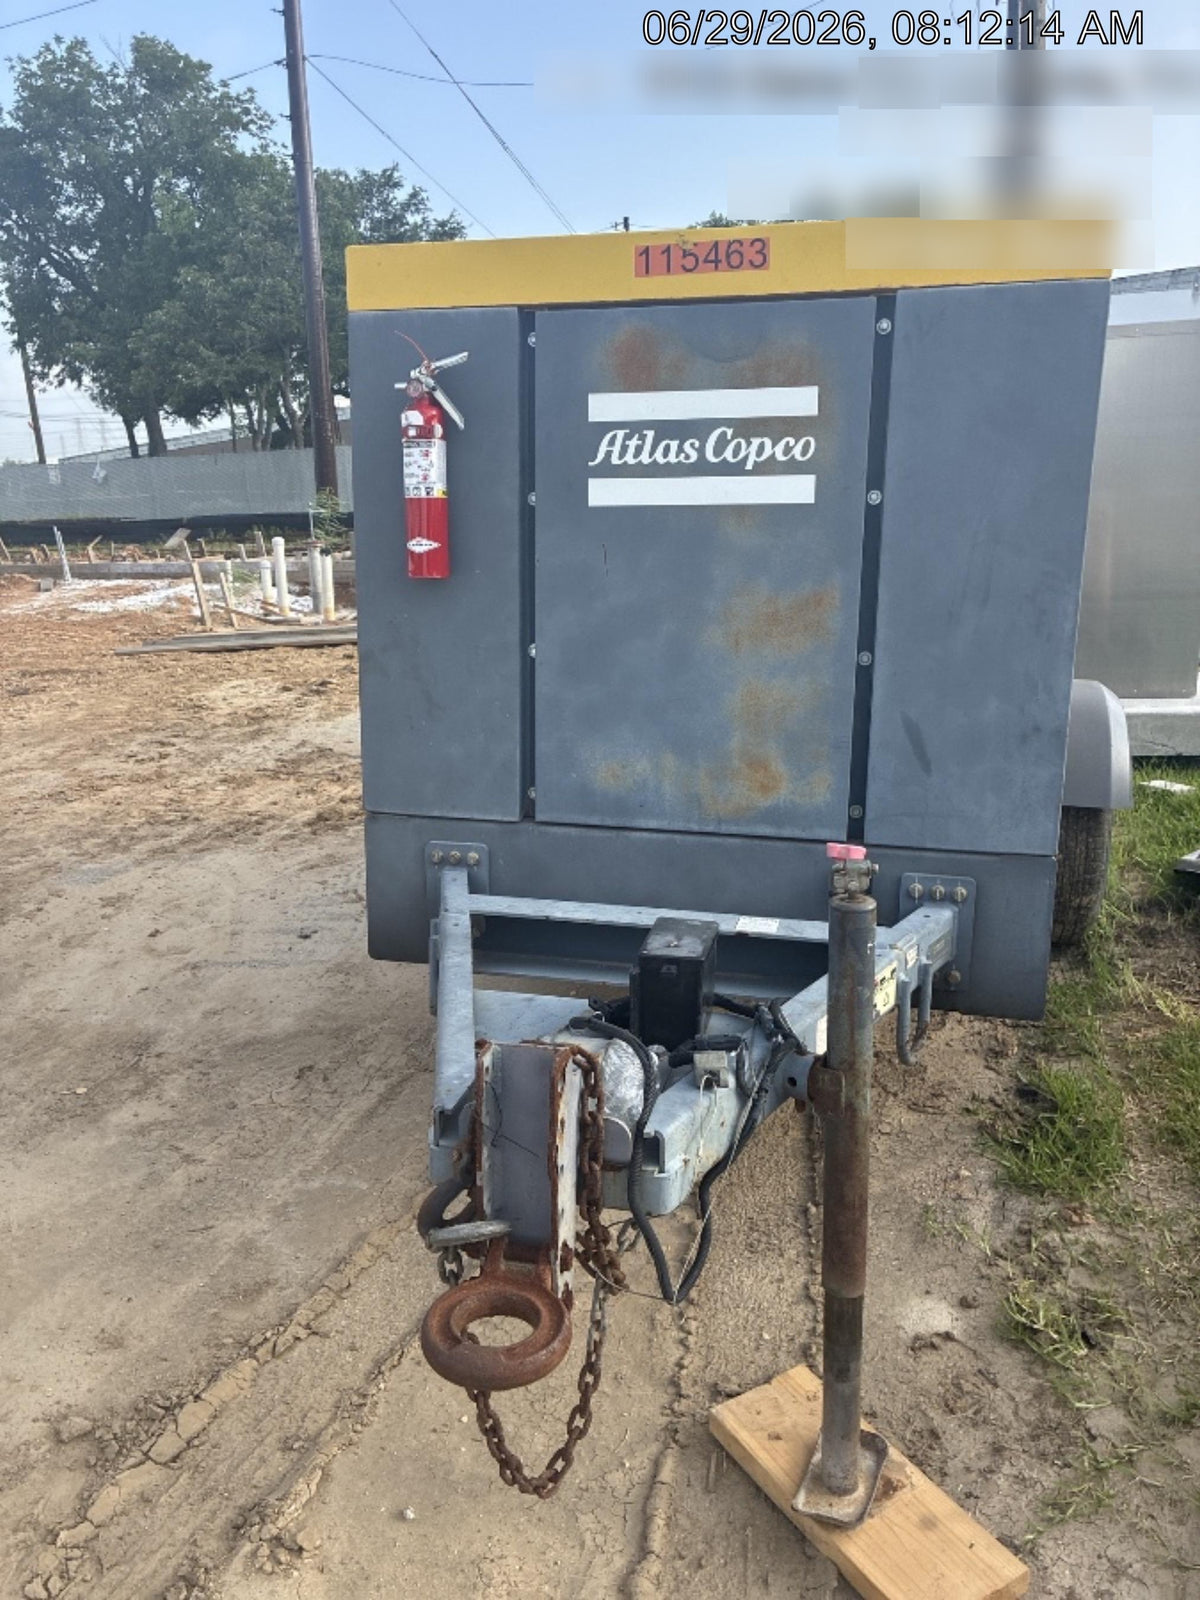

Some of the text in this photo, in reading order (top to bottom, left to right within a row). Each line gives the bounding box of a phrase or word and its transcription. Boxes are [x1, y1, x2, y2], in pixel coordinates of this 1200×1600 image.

[638, 238, 768, 275] 115463
[588, 426, 816, 470] Atlas Copco
